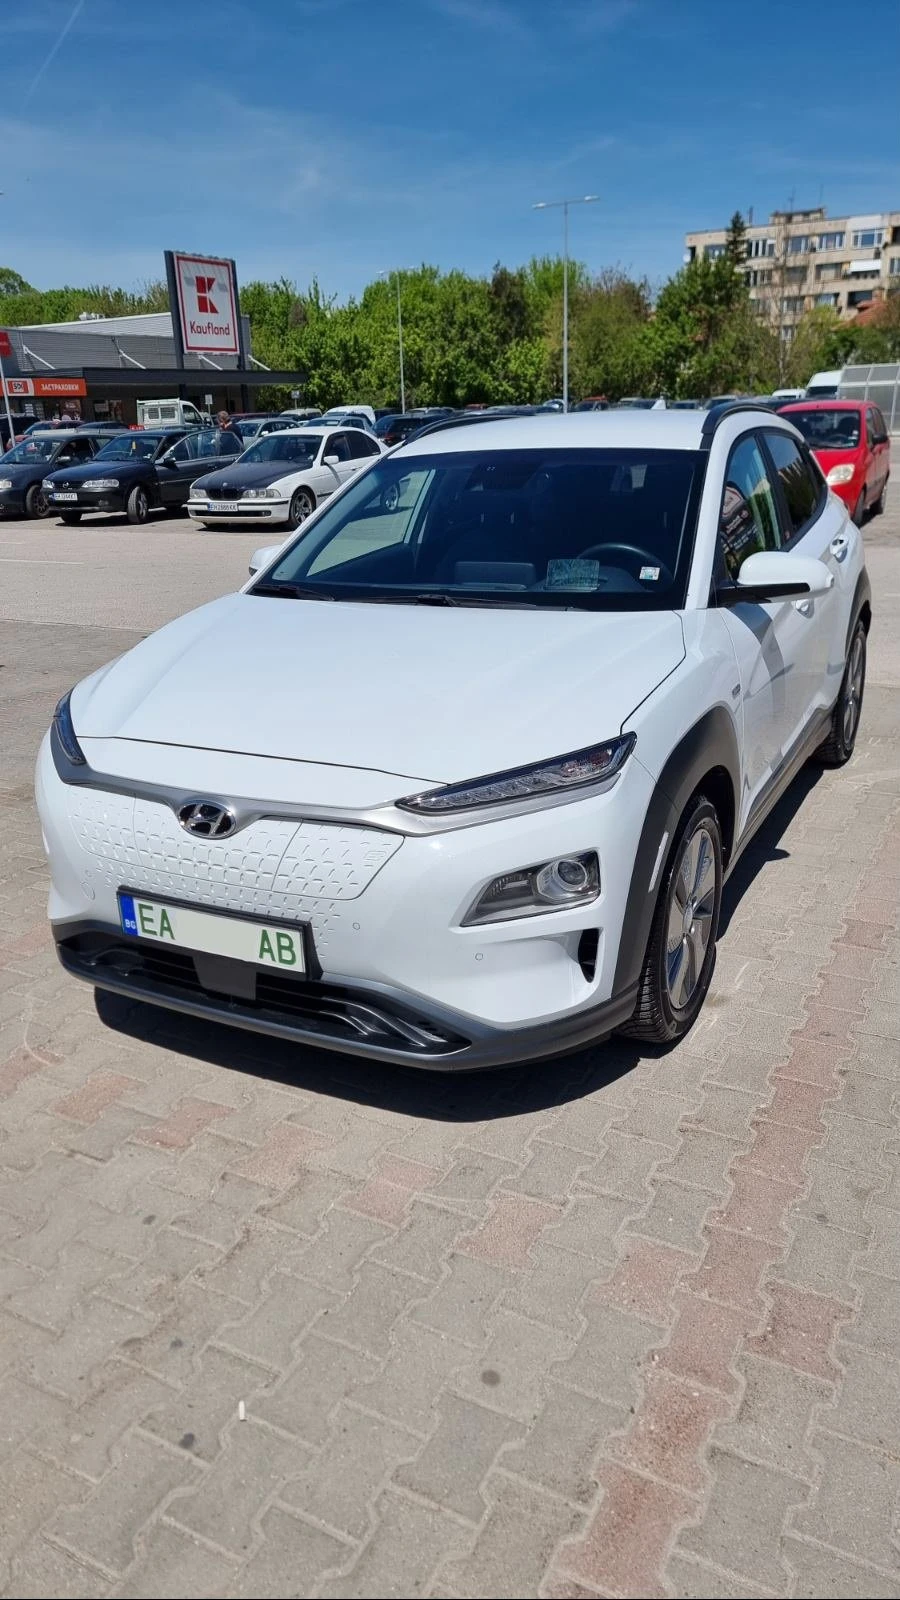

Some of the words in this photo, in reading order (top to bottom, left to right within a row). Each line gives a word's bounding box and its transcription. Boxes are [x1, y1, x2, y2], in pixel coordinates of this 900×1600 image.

[190, 320, 230, 335] Kaufland
[124, 918, 136, 930] BG
[138, 903, 175, 940] EA
[259, 929, 297, 966] AB
